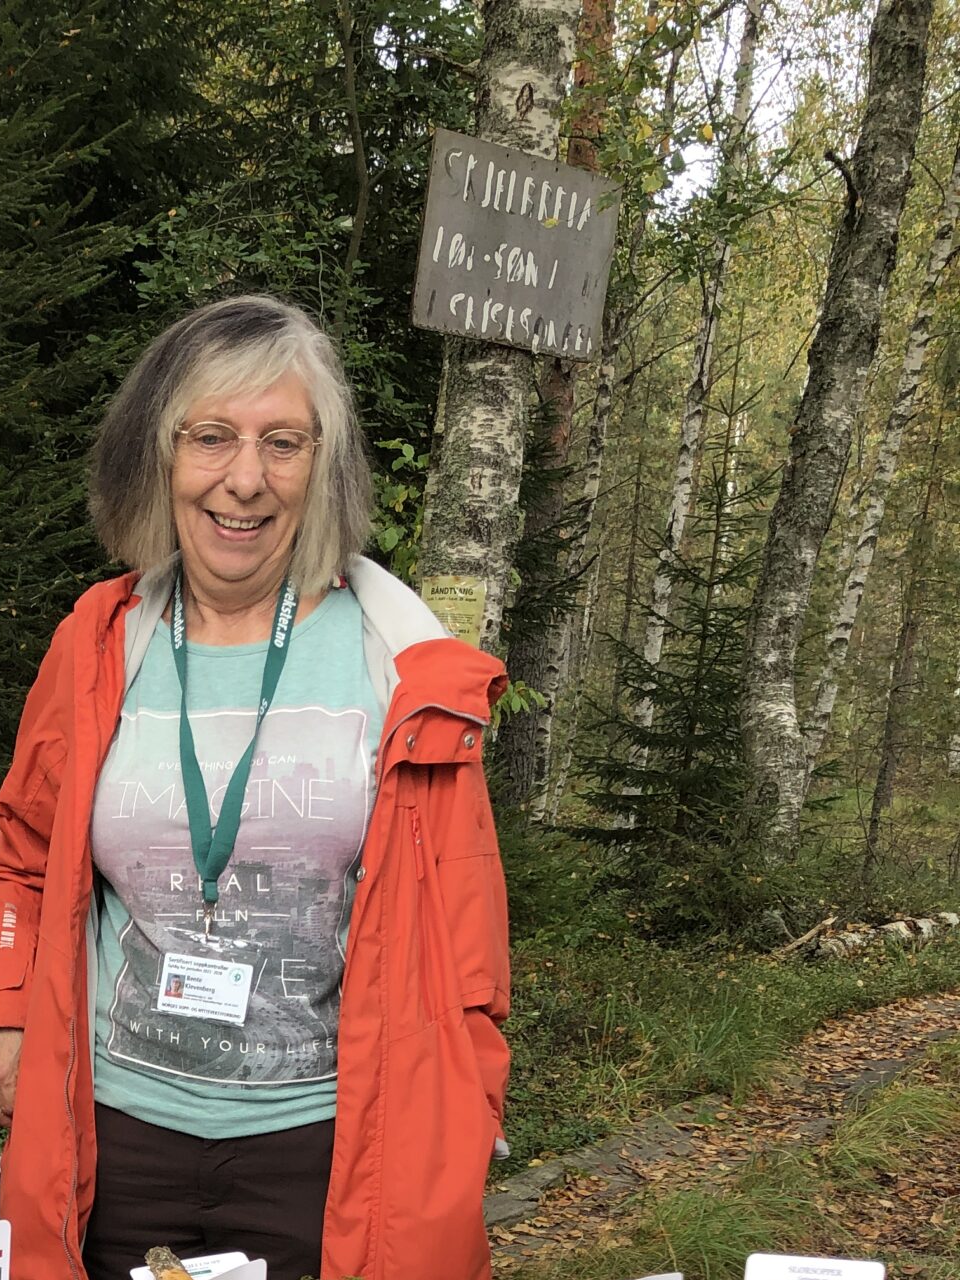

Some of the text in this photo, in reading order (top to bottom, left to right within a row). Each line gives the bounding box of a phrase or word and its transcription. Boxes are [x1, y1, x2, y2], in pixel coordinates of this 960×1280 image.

[158, 760, 233, 771] EVETHING
[268, 755, 296, 765] CAN
[196, 909, 231, 922] FLL
[129, 1020, 335, 1054] WITH YOUR LIFE
